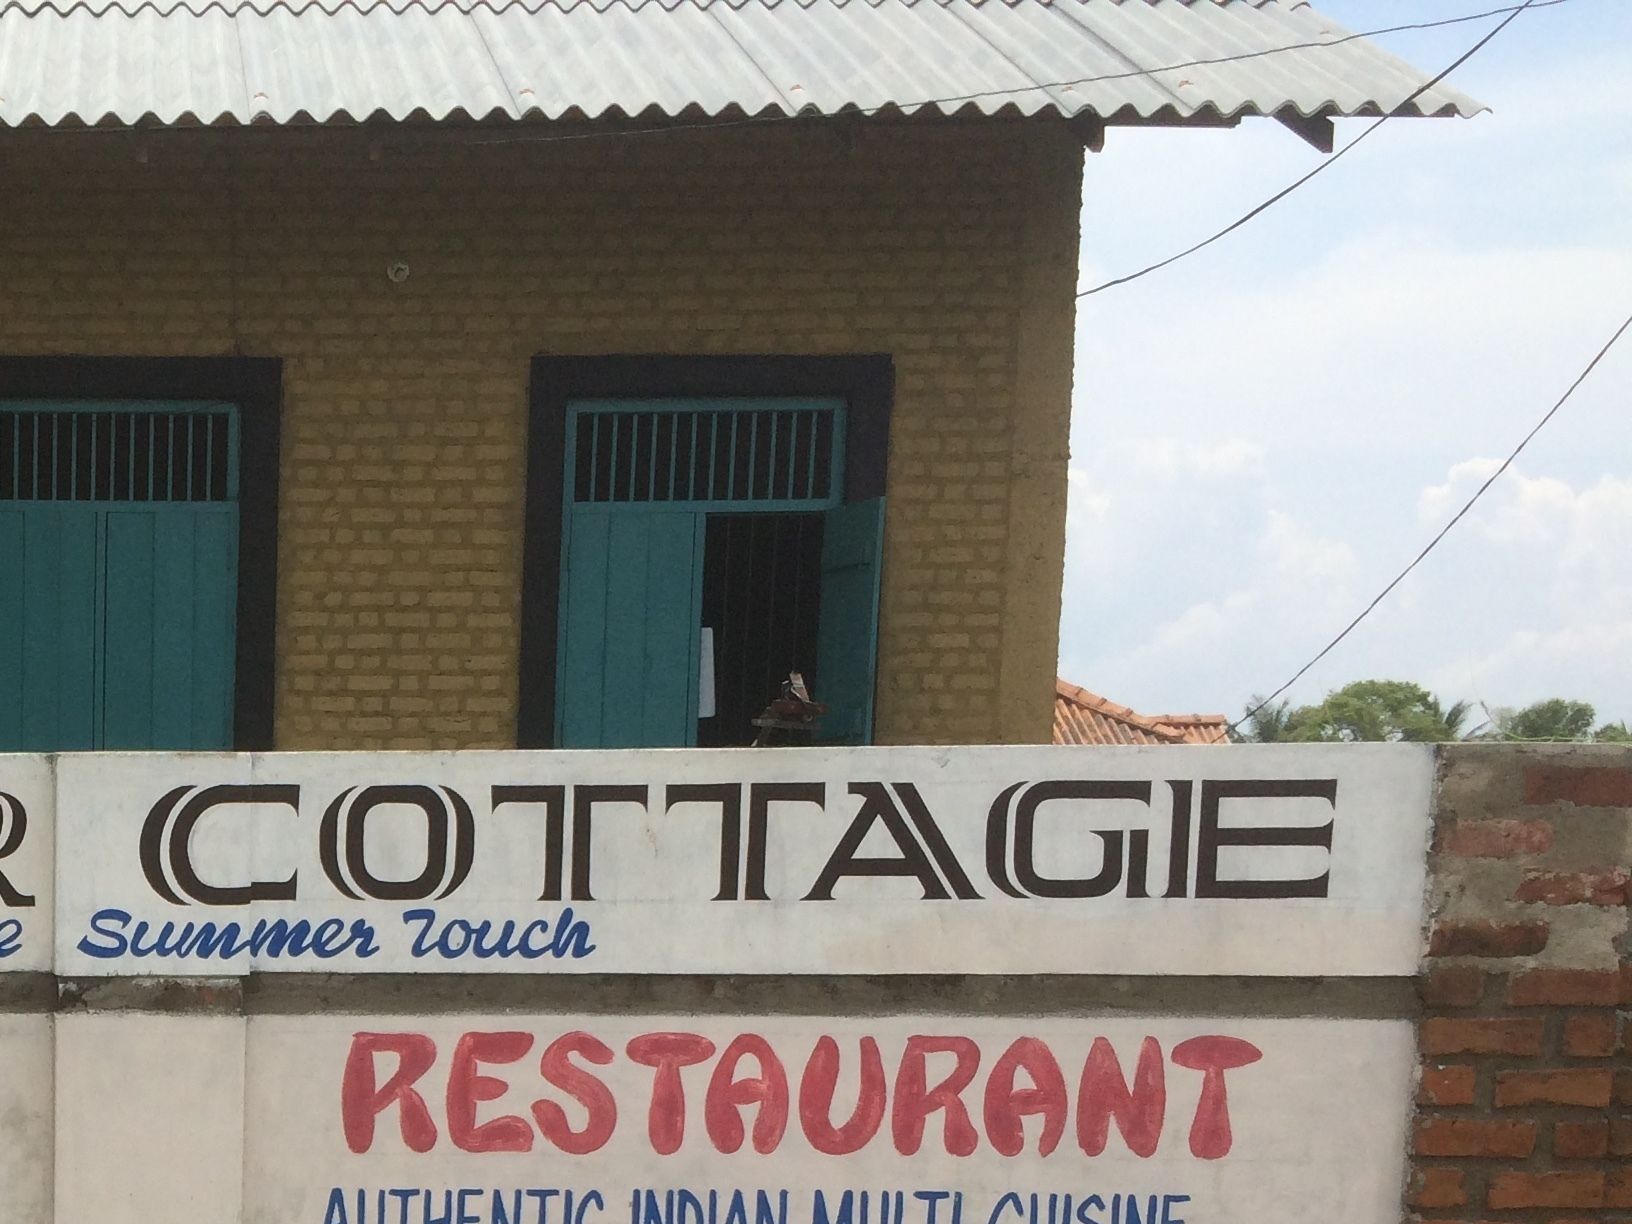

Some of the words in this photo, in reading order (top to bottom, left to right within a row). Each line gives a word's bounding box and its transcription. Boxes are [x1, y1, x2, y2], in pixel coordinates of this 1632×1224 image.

[140, 779, 1337, 906] COTTAGE
[78, 908, 379, 959] Summer
[403, 908, 596, 959] Touch
[343, 1031, 1262, 1159] RESTAURANT
